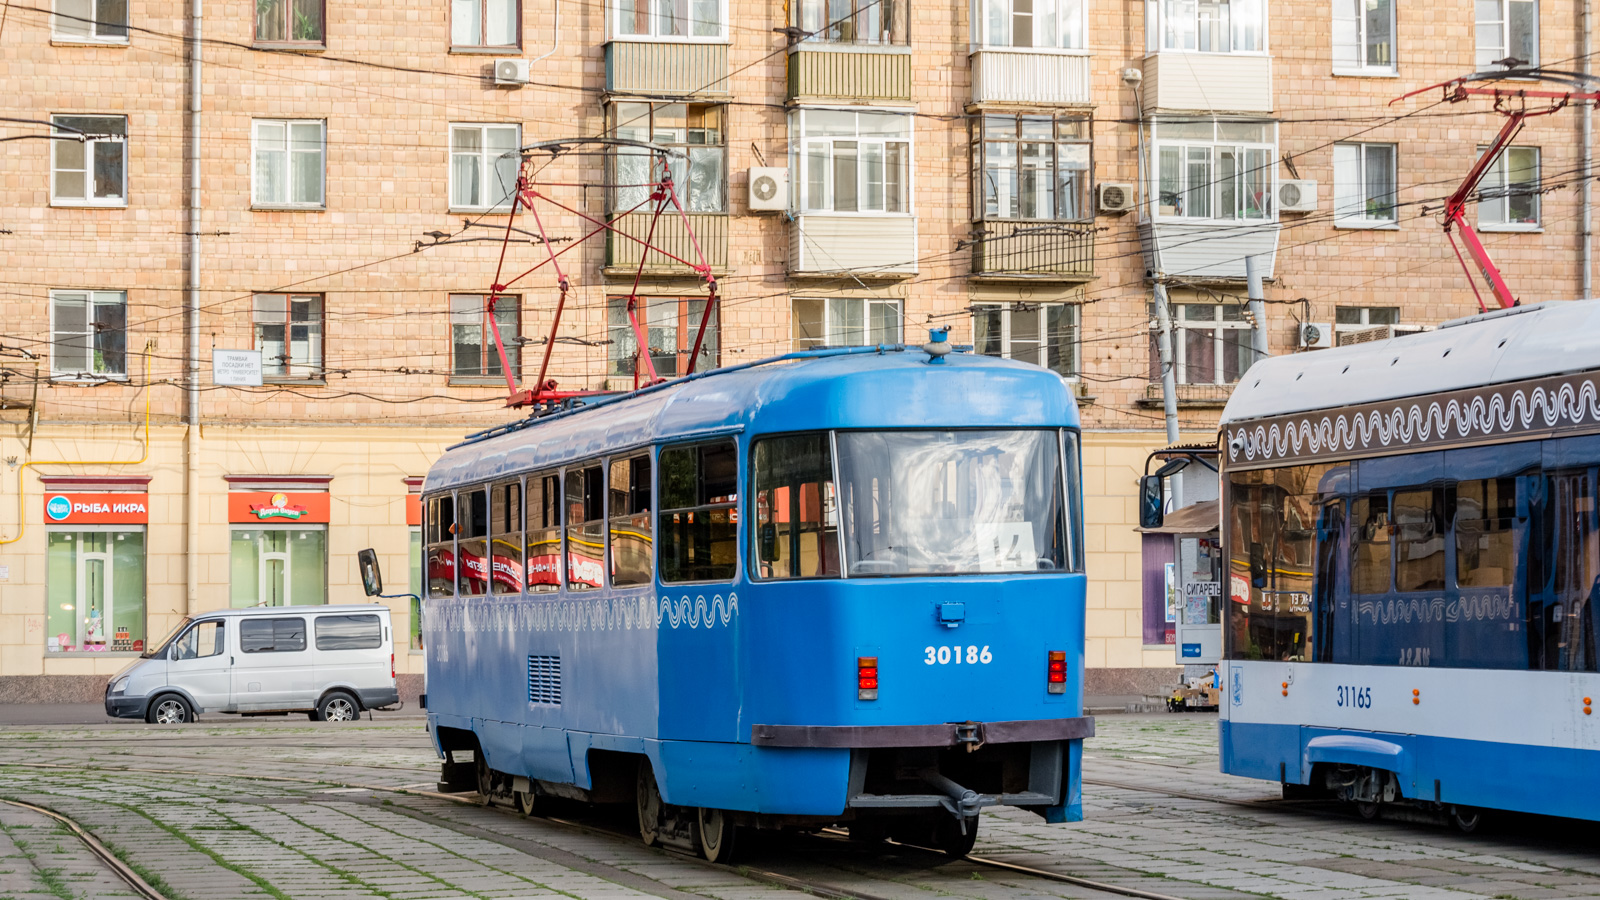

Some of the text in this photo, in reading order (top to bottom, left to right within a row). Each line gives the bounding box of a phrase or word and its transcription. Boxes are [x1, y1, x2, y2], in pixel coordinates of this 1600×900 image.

[73, 503, 110, 513] РЫБА
[112, 503, 146, 513] ИКРА
[260, 508, 279, 516] Дары
[924, 644, 993, 665] 30186
[1337, 685, 1372, 709] 31165
